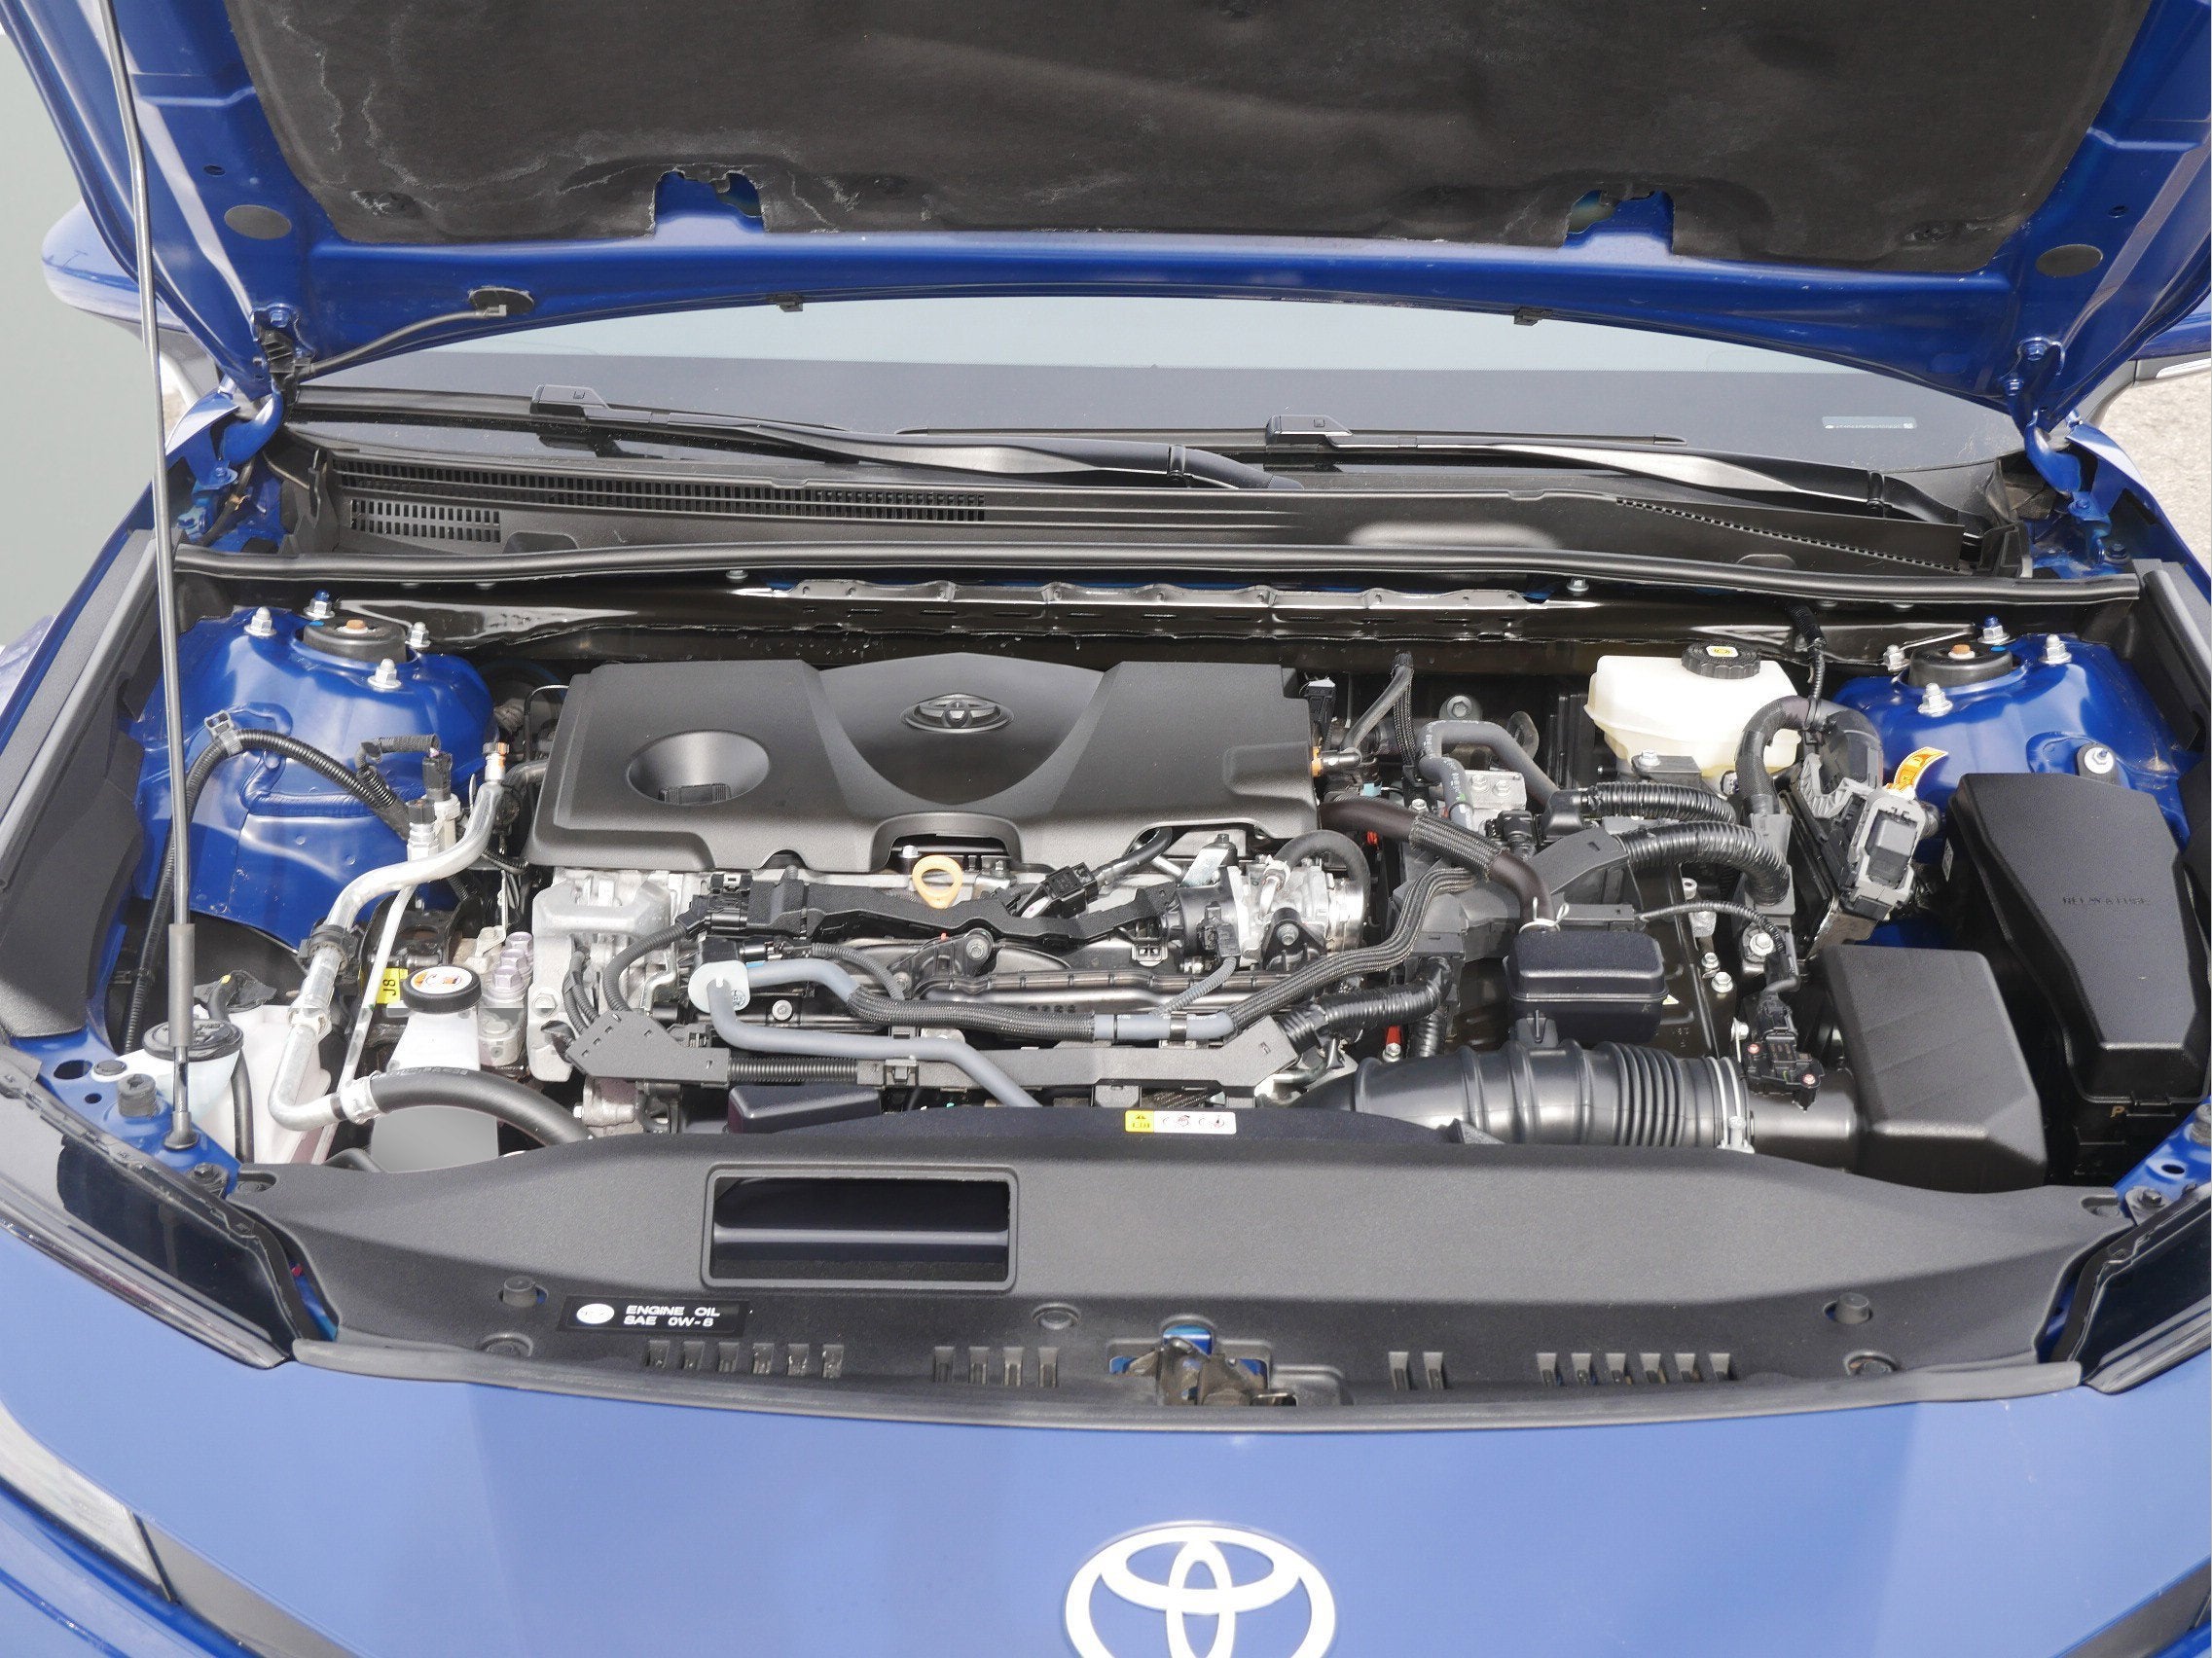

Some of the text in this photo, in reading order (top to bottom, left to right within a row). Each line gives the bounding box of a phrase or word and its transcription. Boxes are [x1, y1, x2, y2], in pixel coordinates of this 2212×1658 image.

[382, 979, 396, 996] J8
[626, 1305, 720, 1316] ENGINE OIL
[624, 1316, 657, 1325] SAE
